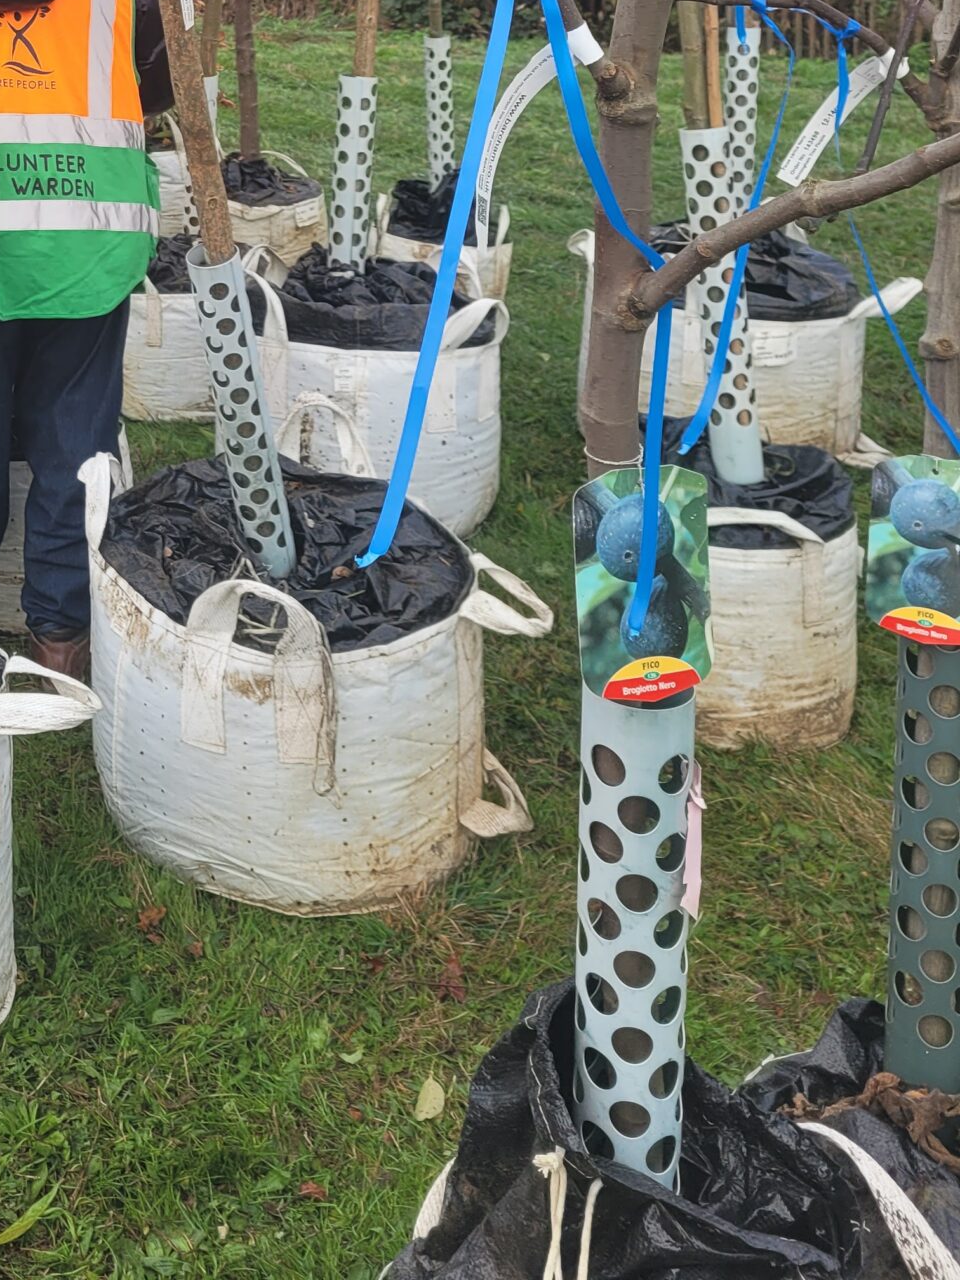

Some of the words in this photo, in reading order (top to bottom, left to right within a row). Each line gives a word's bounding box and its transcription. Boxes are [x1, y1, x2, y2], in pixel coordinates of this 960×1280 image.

[16, 79, 57, 90] PEOPLE
[484, 94, 527, 193] www.barcham.co.uk
[11, 177, 95, 198] WARDEN
[917, 610, 934, 619] FICO
[642, 660, 660, 670] FICO
[658, 681, 676, 691] Nero
